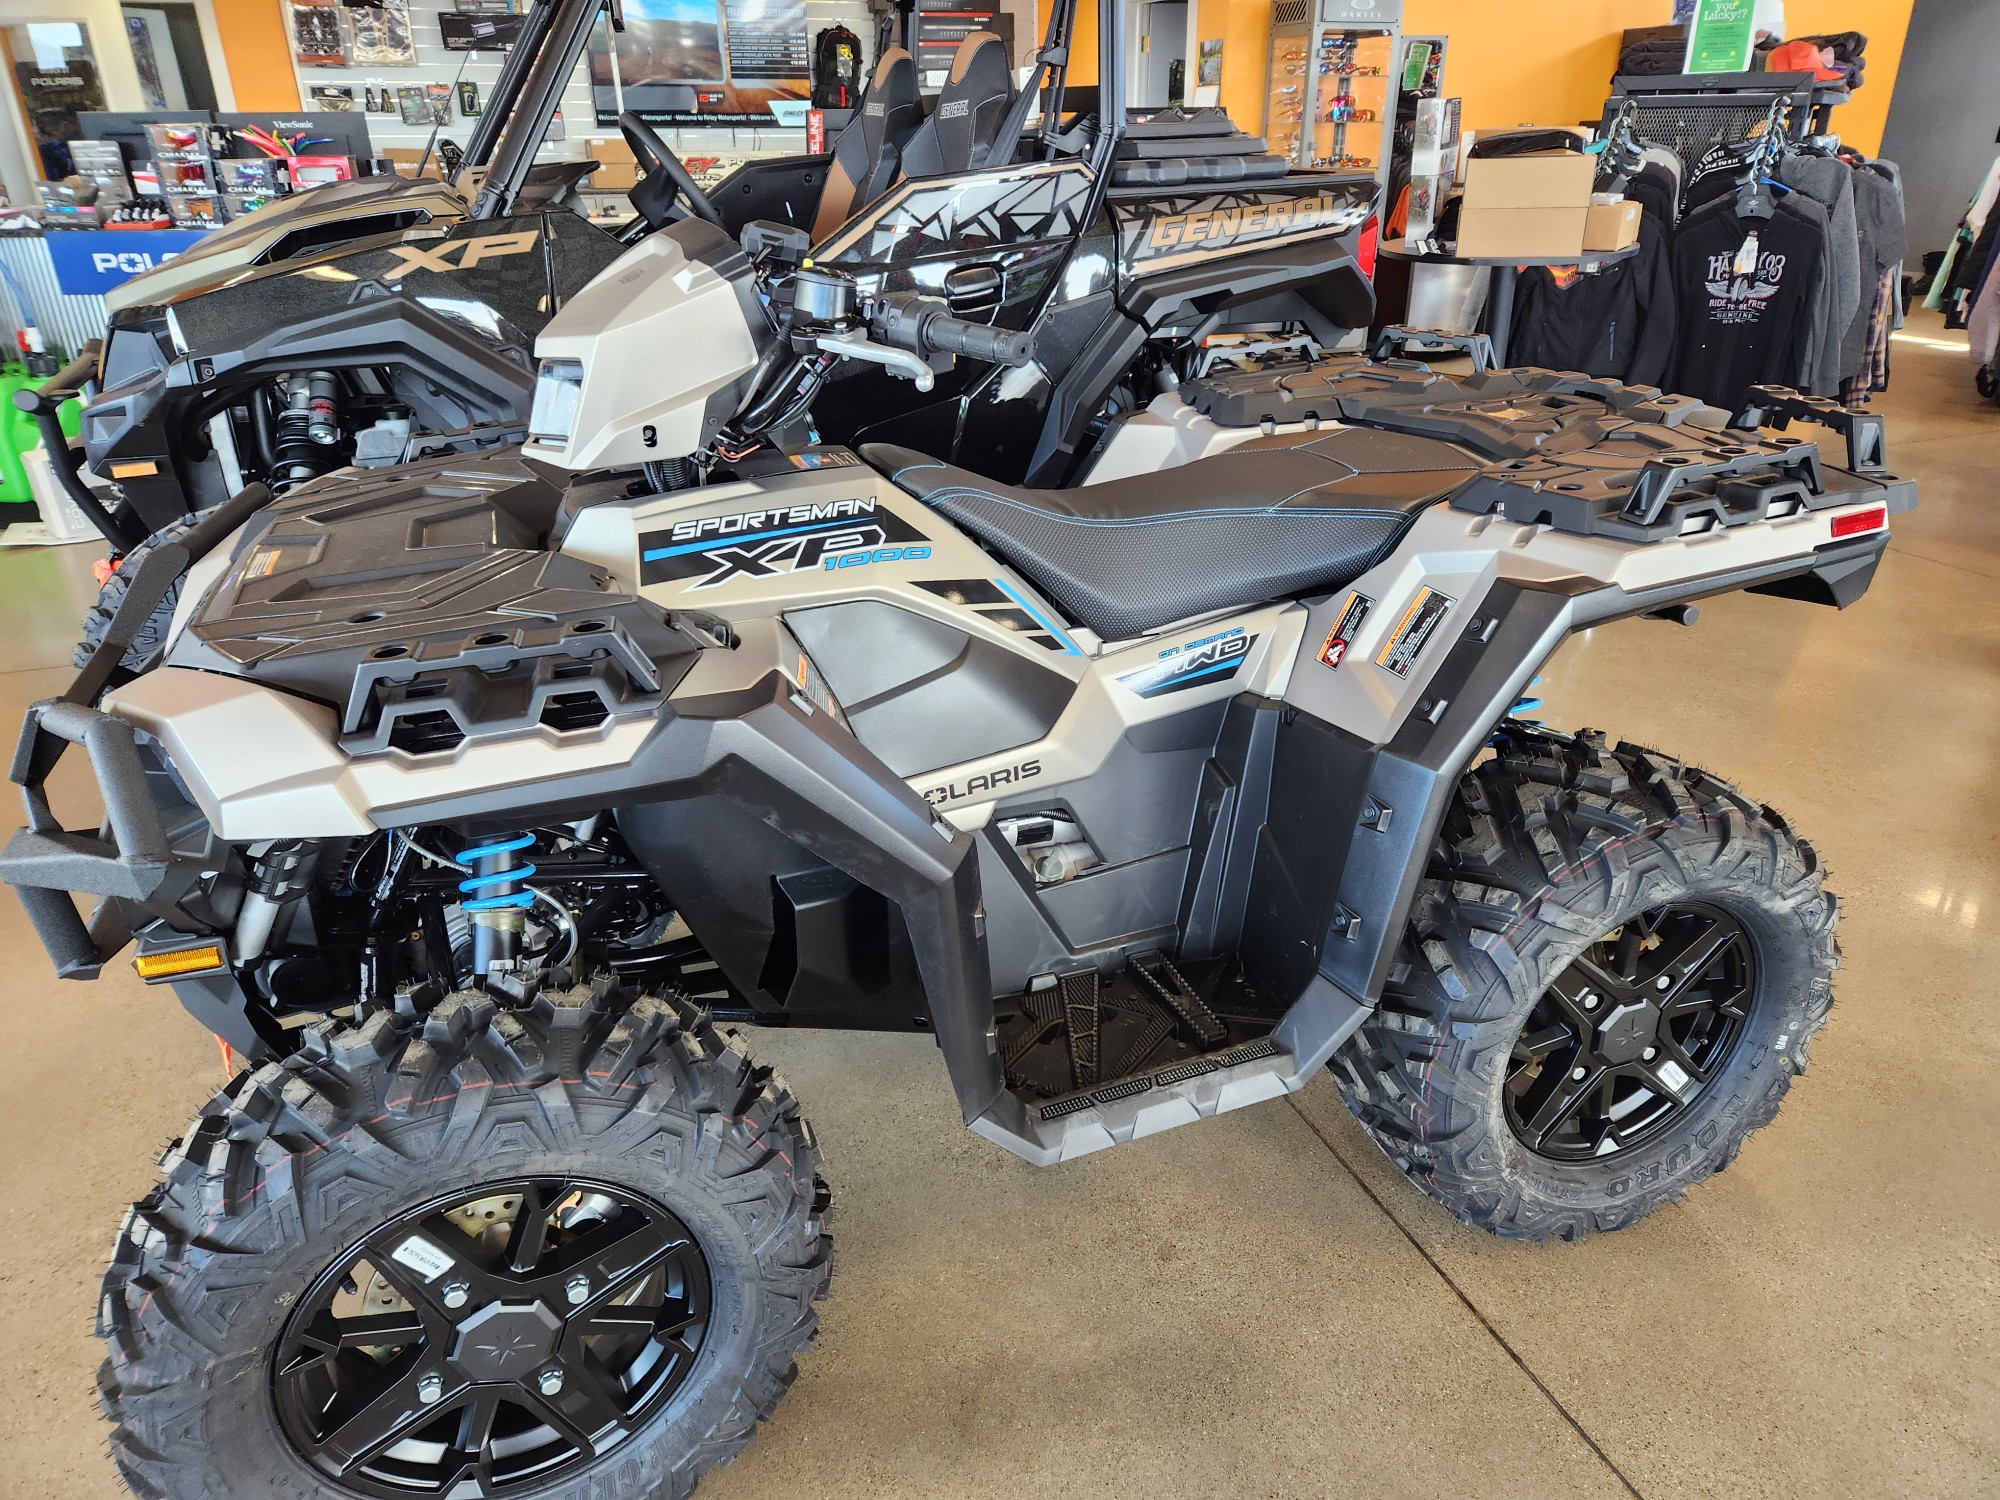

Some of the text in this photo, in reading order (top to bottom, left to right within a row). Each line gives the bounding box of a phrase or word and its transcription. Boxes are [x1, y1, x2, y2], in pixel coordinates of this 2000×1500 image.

[1340, 11, 1382, 19] OAKLEY
[272, 120, 314, 129] ViewSonic
[1149, 196, 1344, 248] GENERAL
[383, 230, 540, 280] XP
[1709, 299, 1727, 307] RIDE
[1747, 299, 1768, 310] FREE
[671, 496, 878, 541] SPORTSMAN
[678, 524, 932, 594] XP 1000
[1152, 633, 1252, 681] AWD
[1159, 626, 1245, 659] ON DEMAND
[922, 759, 1043, 806] OLARIS
